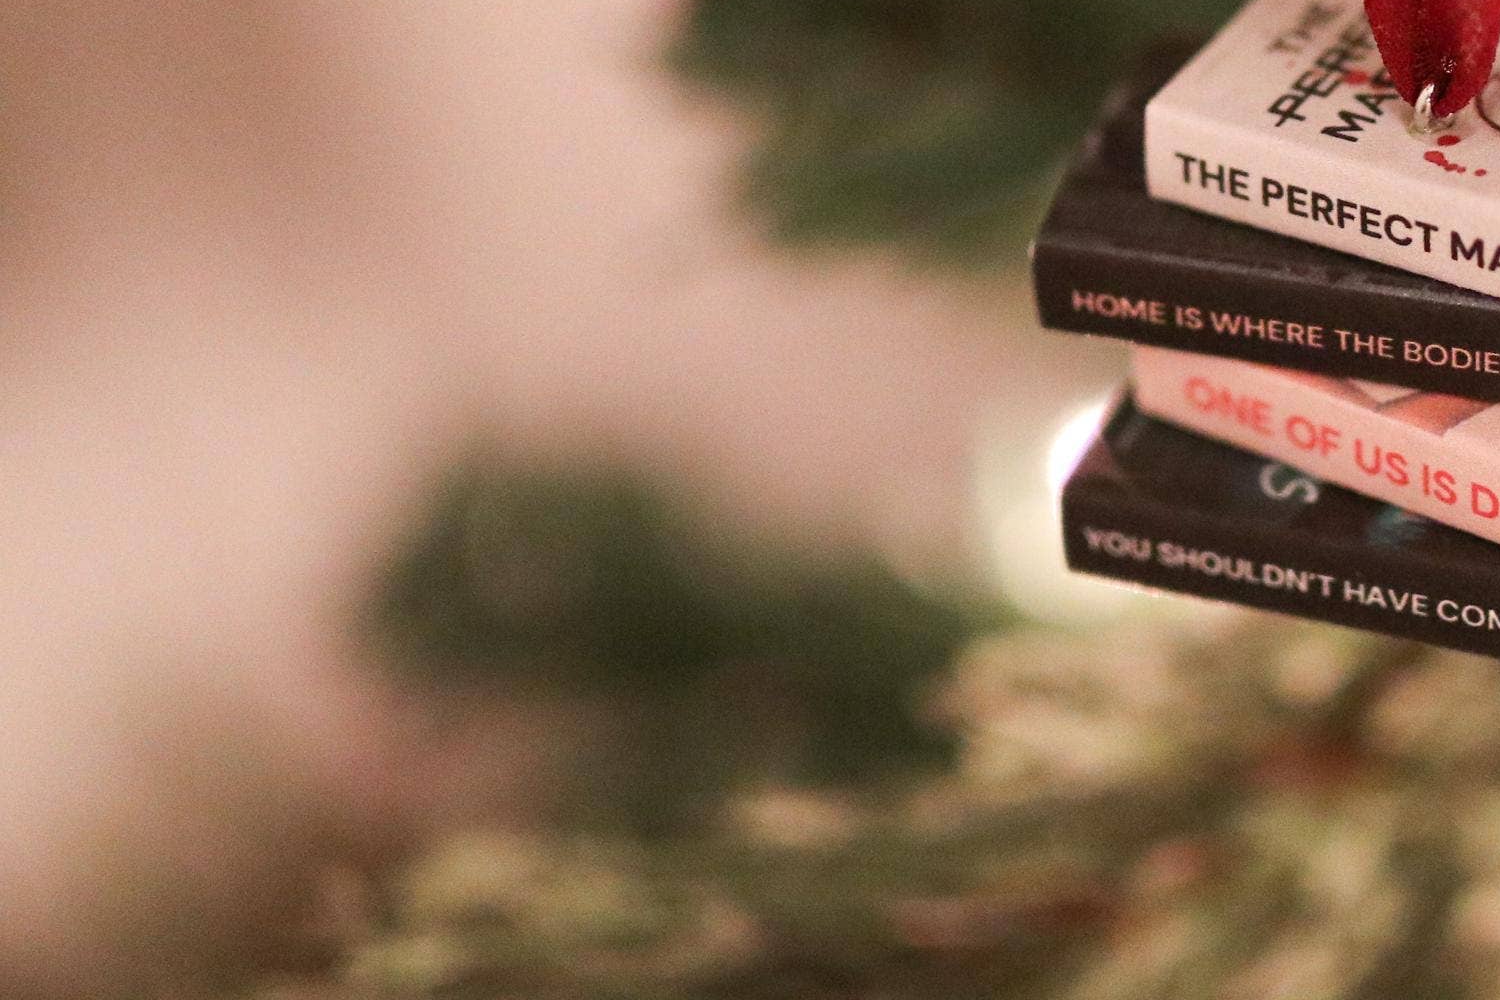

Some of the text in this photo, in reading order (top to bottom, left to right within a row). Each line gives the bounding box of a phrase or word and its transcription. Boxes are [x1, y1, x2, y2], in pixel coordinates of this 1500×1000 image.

[1174, 151, 1251, 202] THE
[1261, 176, 1439, 253] PERFECT
[1070, 289, 1167, 326] HOME
[1174, 305, 1204, 330] IS
[1209, 310, 1325, 348] WHERE
[1333, 328, 1395, 360] THE
[1184, 375, 1275, 438] ONE
[1284, 414, 1342, 457] OF
[1353, 438, 1410, 487] US
[1422, 463, 1458, 506] IS
[1083, 525, 1151, 561] YOU
[1156, 540, 1336, 597] SHOULDN'T
[1343, 579, 1428, 617] HAVE
